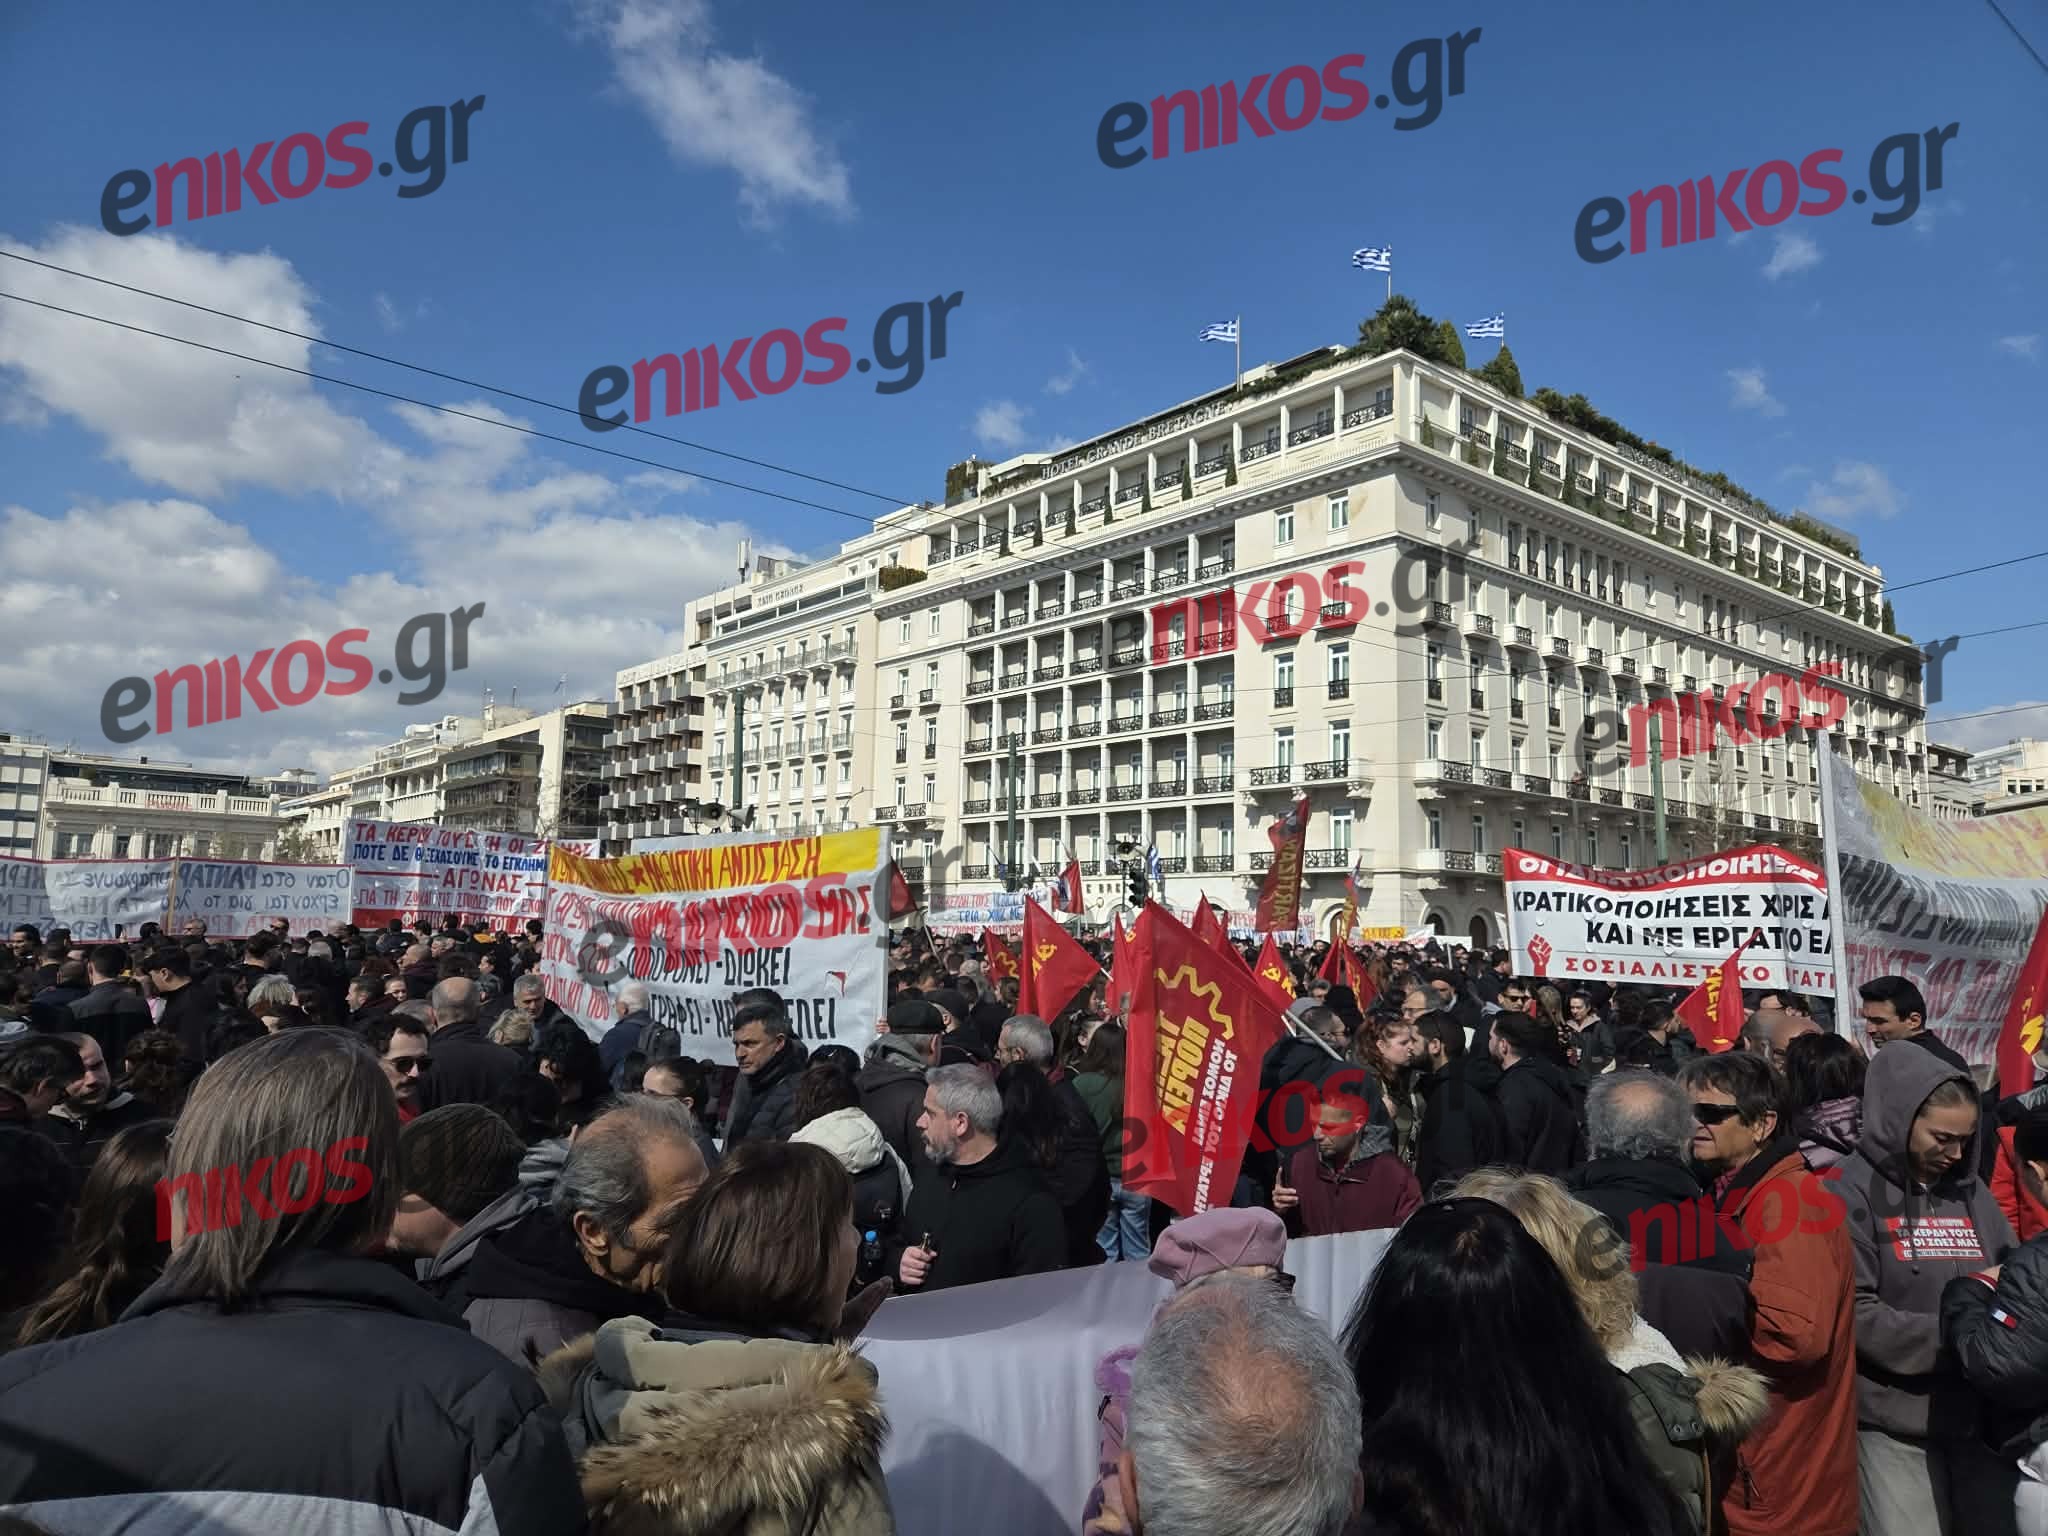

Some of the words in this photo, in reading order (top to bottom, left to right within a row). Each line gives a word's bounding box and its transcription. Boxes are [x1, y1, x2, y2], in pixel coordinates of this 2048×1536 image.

[1041, 458, 1081, 481] HOTEL
[1087, 434, 1142, 463] GRANDE
[1149, 401, 1228, 440] BRETAGNE
[356, 824, 377, 842] ΤΑ
[353, 844, 386, 860] ΠΟΤΕ
[392, 845, 410, 861] ΔΕ
[485, 854, 499, 868] ΤΟ
[641, 848, 713, 892] ΜΑΘΗΤΙΚΗ
[719, 836, 821, 889] ΑΝΤΙΣΤΑΣΗ
[1519, 857, 1550, 874] ΟΙ
[441, 868, 523, 893] ΑΓΩΝΑΣ
[359, 889, 377, 905] ΓΙΑ
[384, 890, 397, 905] ΤΗ
[1512, 891, 1751, 919] ΚΡΑΤΙΚΟΠΟΙΗΣΕΙΣ
[1760, 894, 1814, 920] ΧΡΙΣ
[816, 885, 871, 936] ΜΑΣ
[1587, 922, 1633, 945] ΚΑΙ
[1643, 927, 1683, 949] ΜΕ
[1565, 957, 1770, 981] ΣΟΣΙΑΛΙΣΤΚΟ
[648, 993, 703, 1035] ΓΡΑΦΕΙ
